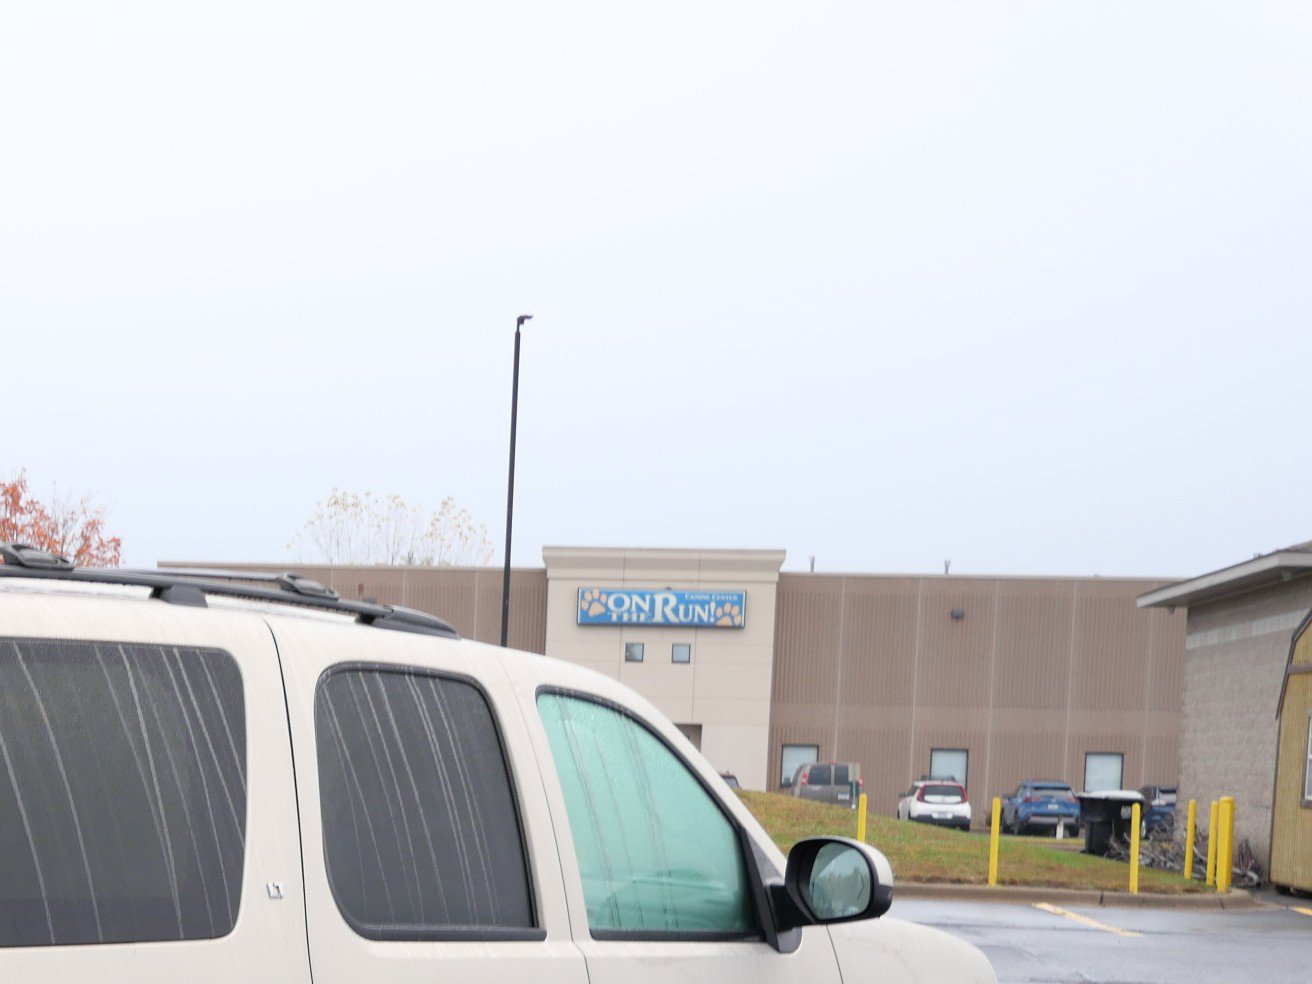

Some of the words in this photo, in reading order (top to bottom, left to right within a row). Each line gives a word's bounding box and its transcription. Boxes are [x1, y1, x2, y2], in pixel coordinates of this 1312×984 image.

[607, 593, 650, 612] ON
[652, 592, 716, 623] RUN!
[609, 610, 650, 622] THE
